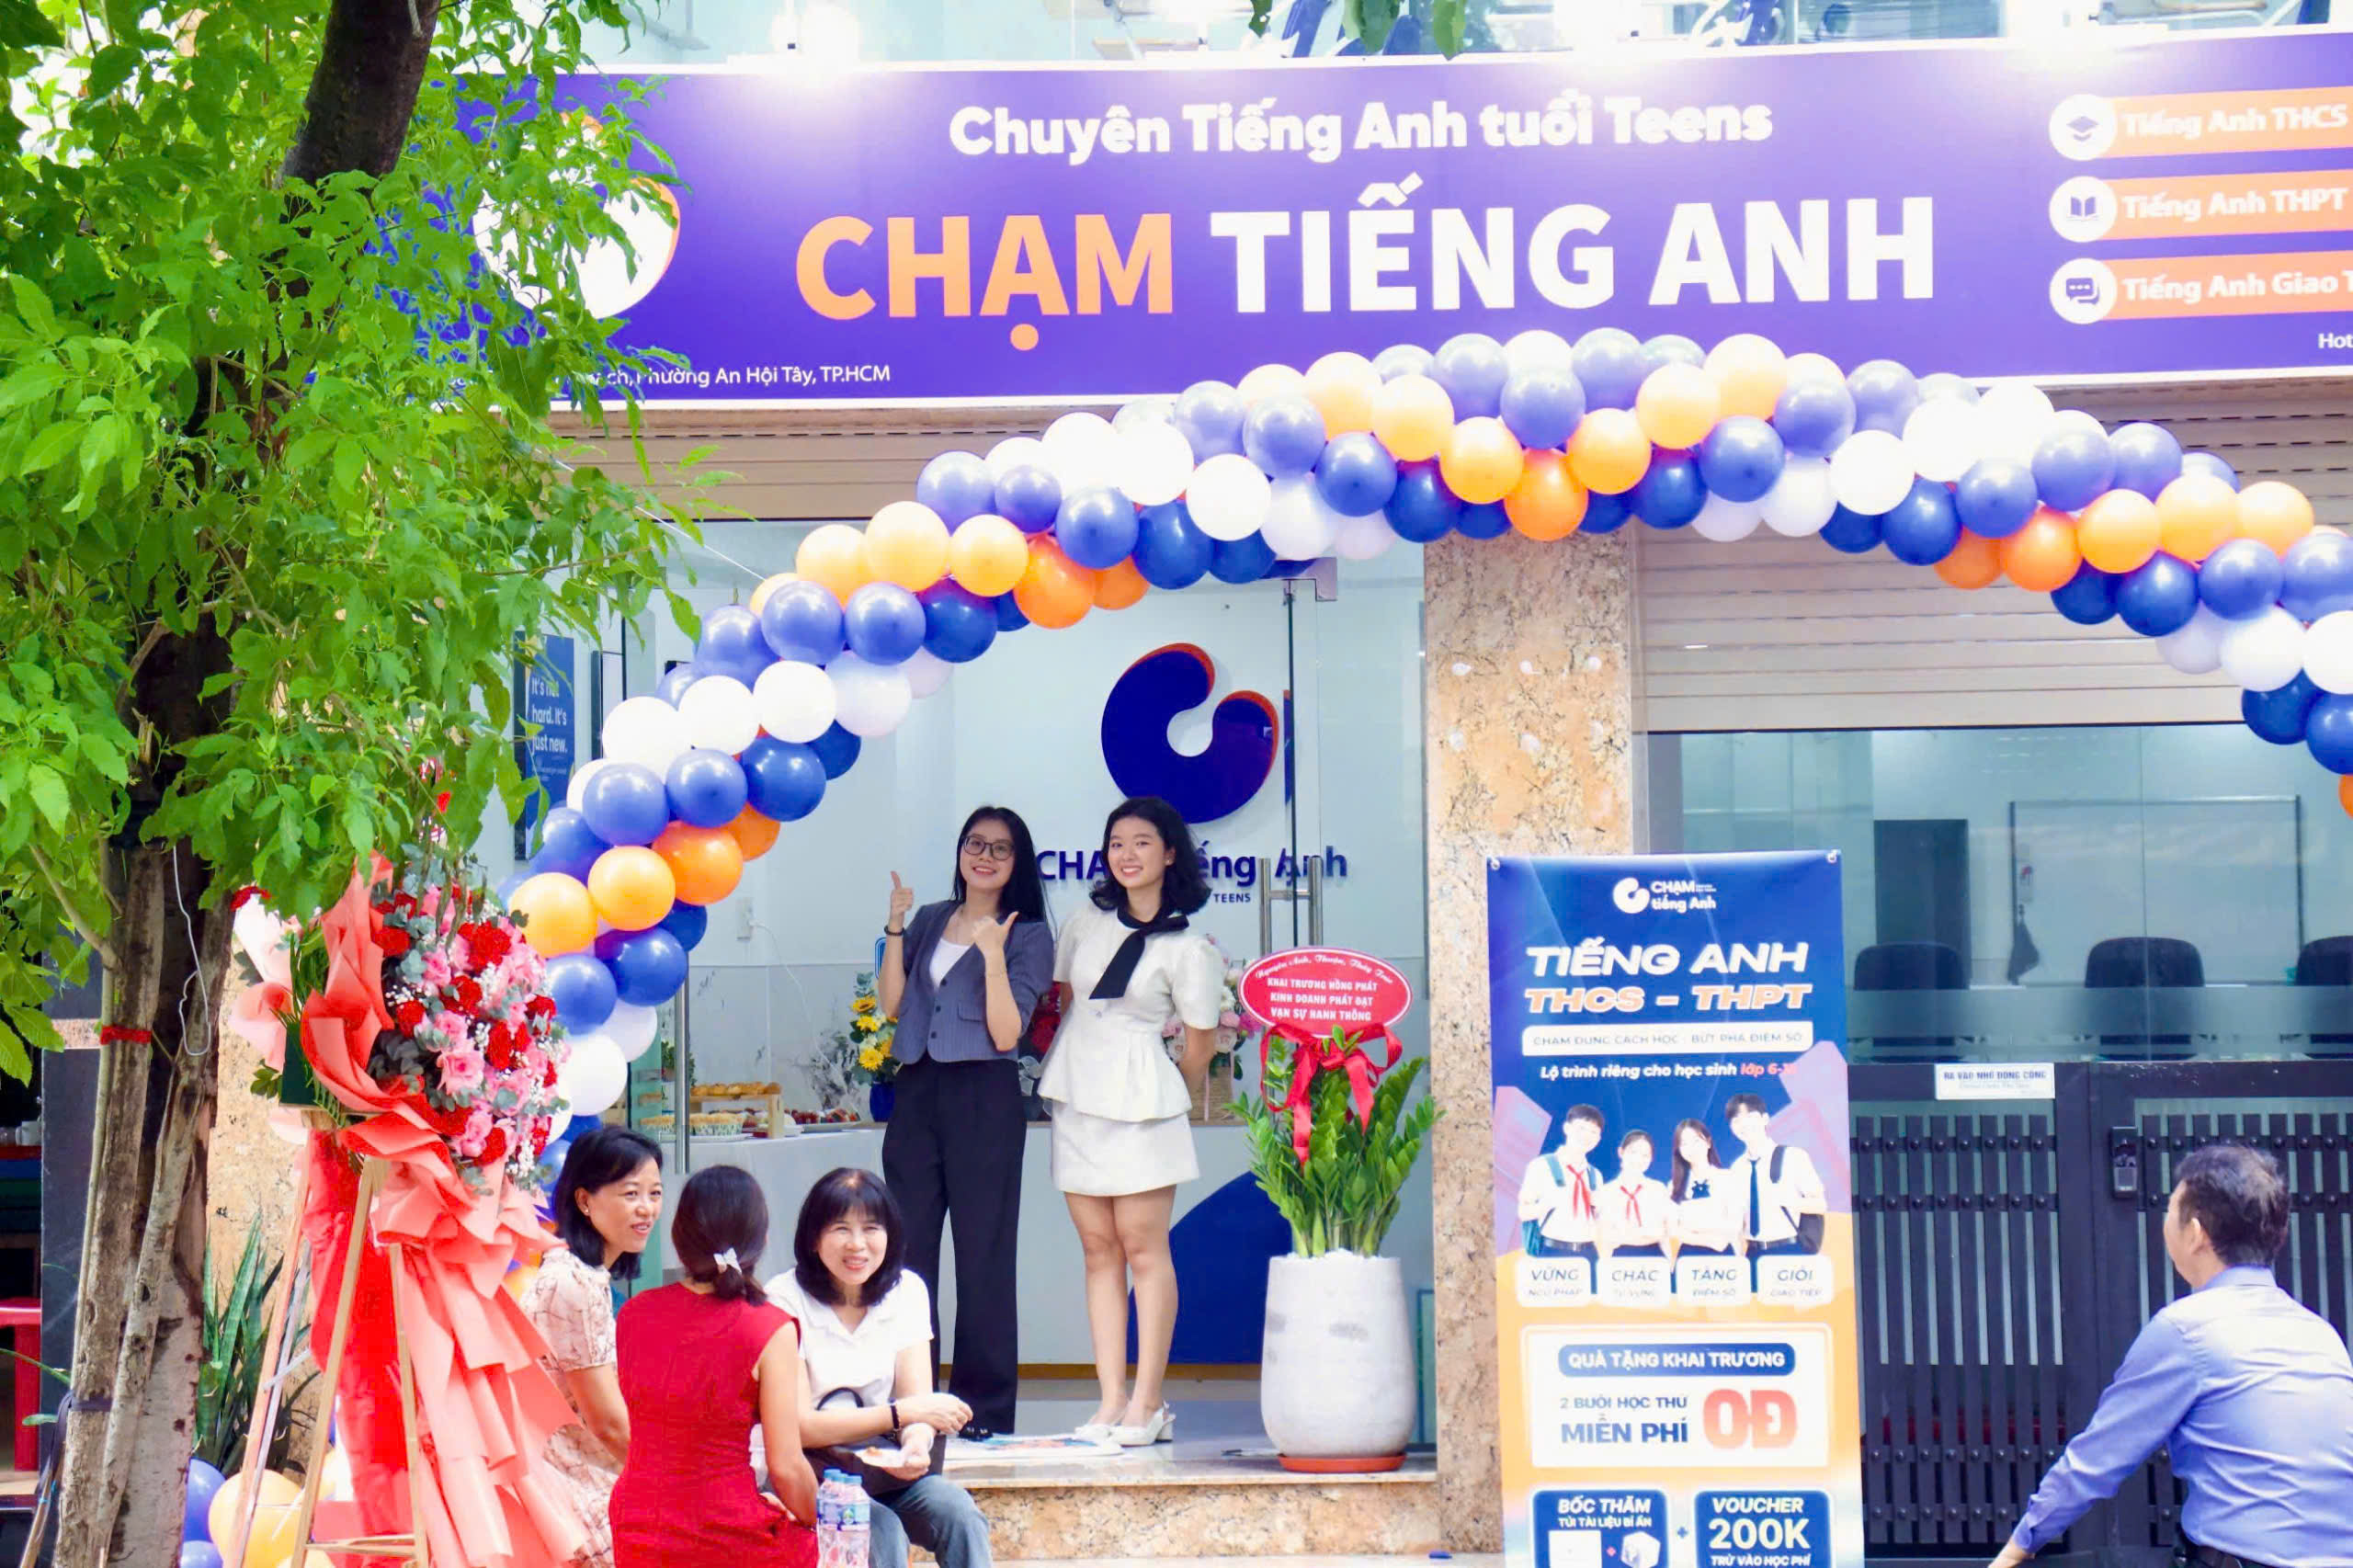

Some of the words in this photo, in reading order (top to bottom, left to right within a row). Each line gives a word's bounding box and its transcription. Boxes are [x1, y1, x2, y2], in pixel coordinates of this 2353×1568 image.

[949, 104, 1170, 165] Chuyên
[1182, 97, 1342, 163] Tiếng
[1354, 101, 1467, 152] Anh
[1480, 88, 1593, 148] tuổi
[1604, 96, 1773, 143] Teens
[2207, 108, 2268, 132] Anh
[2270, 104, 2348, 131] THCS
[2121, 191, 2202, 222] Tiếng
[2207, 190, 2267, 215] Anh
[2269, 187, 2347, 213] THPT
[796, 213, 1174, 351] CHẠM
[1211, 172, 1614, 313] TIẾNG
[1648, 196, 1934, 305] ANH
[2121, 274, 2202, 304] Tiếng
[2208, 273, 2266, 298] Anh
[2271, 272, 2339, 295] Giao
[2318, 333, 2353, 349] Hot
[715, 368, 741, 384] An
[745, 366, 779, 386] Hội
[781, 365, 817, 386] Tây,
[820, 365, 891, 382] TP.HCM
[546, 680, 560, 698] nt
[532, 704, 554, 724] hard.
[555, 708, 567, 726] It's
[549, 737, 568, 754] new.
[1037, 849, 1109, 888] CHẠ
[1213, 892, 1251, 903] TEENS
[1650, 880, 1696, 896] CHẠM
[1689, 894, 1717, 910] Anh
[1527, 936, 1680, 977] TIẾNG
[1689, 941, 1810, 975] ANH
[1267, 977, 1288, 987] KHAI
[1290, 978, 1326, 990] TRƯƠNG
[1355, 980, 1378, 992] PHÁT
[1269, 992, 1293, 1003] KINH
[1295, 994, 1327, 1005] DOANH
[1329, 994, 1353, 1006] PHÁT
[1524, 985, 1646, 1014] THCS
[1690, 983, 1813, 1011] THPT
[1270, 1006, 1290, 1019] VẠN
[1292, 1008, 1308, 1021] SỰ
[1340, 1007, 1371, 1022] THÔNG
[1643, 1064, 1672, 1077] cho
[1674, 1062, 1702, 1080] học
[1705, 1062, 1737, 1076] sinh
[1568, 1350, 1607, 1369] QUÀ
[1610, 1348, 1659, 1371] TẶNG
[1662, 1351, 1705, 1369] KHAI
[1708, 1350, 1786, 1369] TRƯƠNG
[1560, 1397, 1569, 1410] 2
[1617, 1396, 1652, 1411] HỌC
[1561, 1413, 1632, 1444] MIỄN
[1641, 1416, 1688, 1444] PHÍ
[1557, 1494, 1596, 1515] BỐC
[1599, 1495, 1652, 1514] THĂM
[1711, 1496, 1805, 1514] VOUCHER
[1708, 1517, 1812, 1550] 200K
[1736, 1553, 1763, 1566] VÀO
[1764, 1555, 1790, 1568] HỌC
[1790, 1553, 1812, 1566] PHÍ
